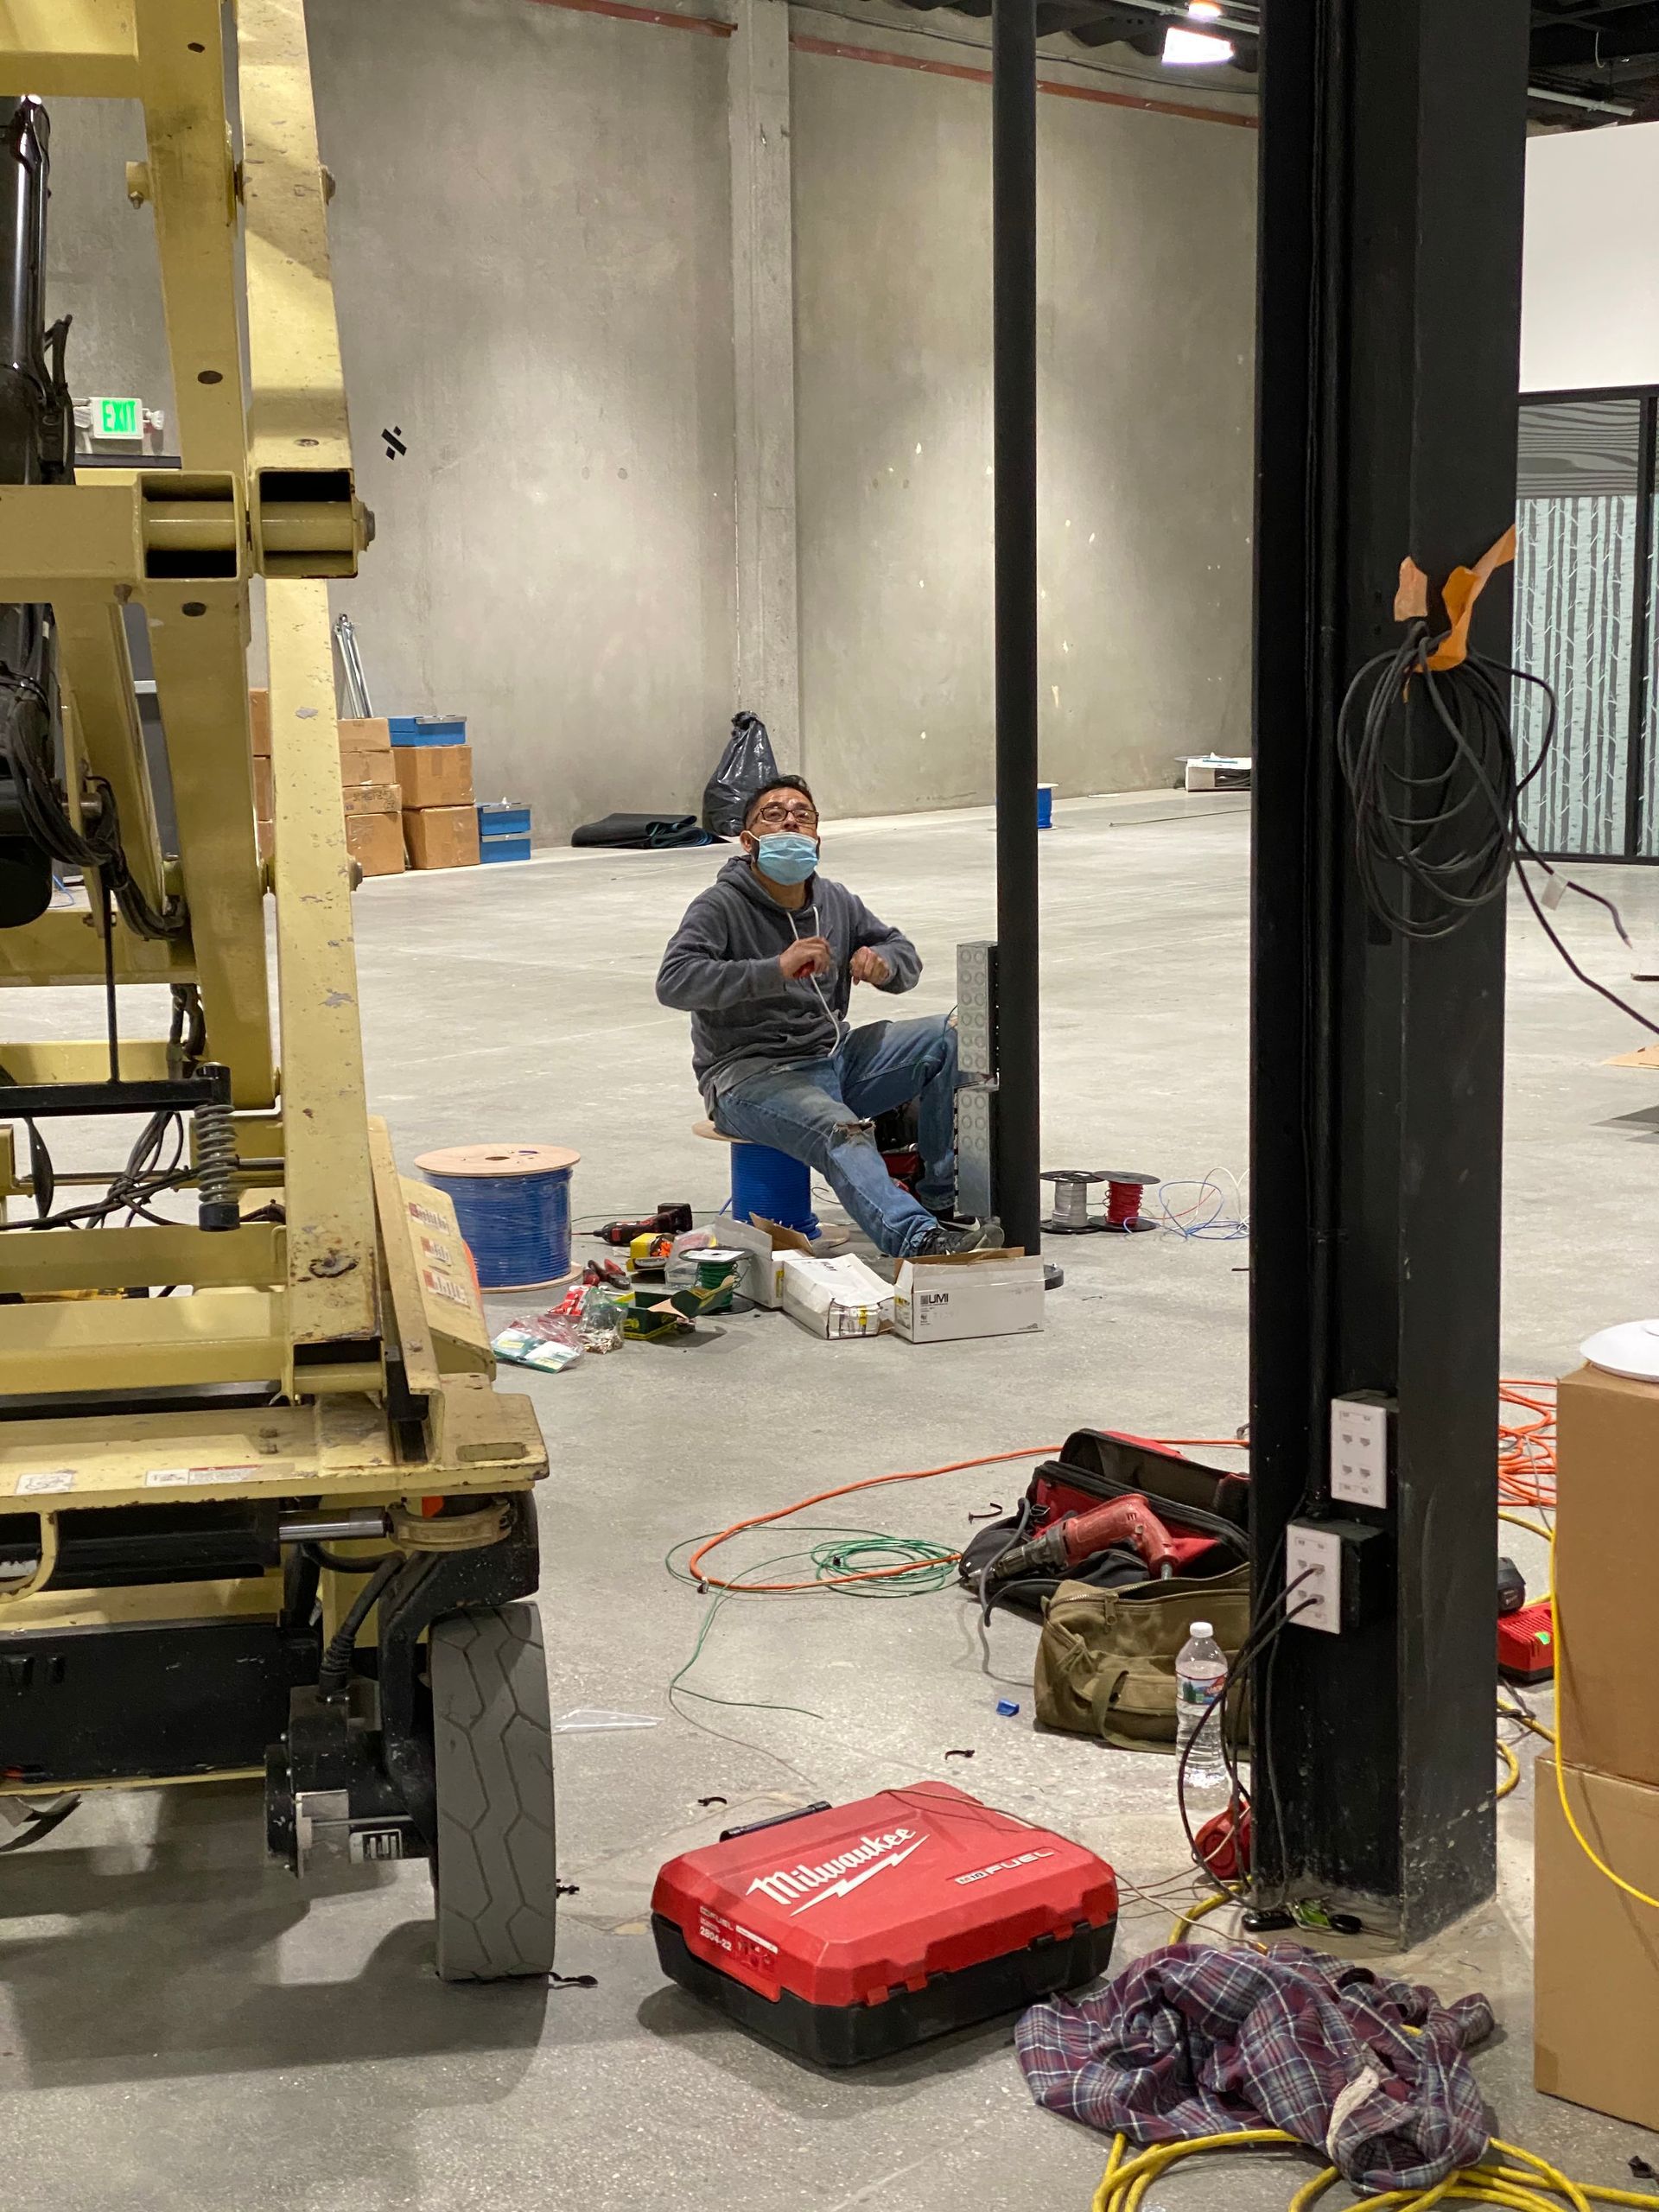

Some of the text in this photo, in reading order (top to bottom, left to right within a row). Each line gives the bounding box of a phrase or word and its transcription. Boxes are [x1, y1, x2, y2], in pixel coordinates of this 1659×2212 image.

[102, 400, 136, 432] EXIT
[928, 1293, 949, 1305] UMI
[746, 1827, 917, 1905] Milwaukee
[984, 1850, 1054, 1876] FUEL
[699, 1926, 733, 1952] 2804-22
